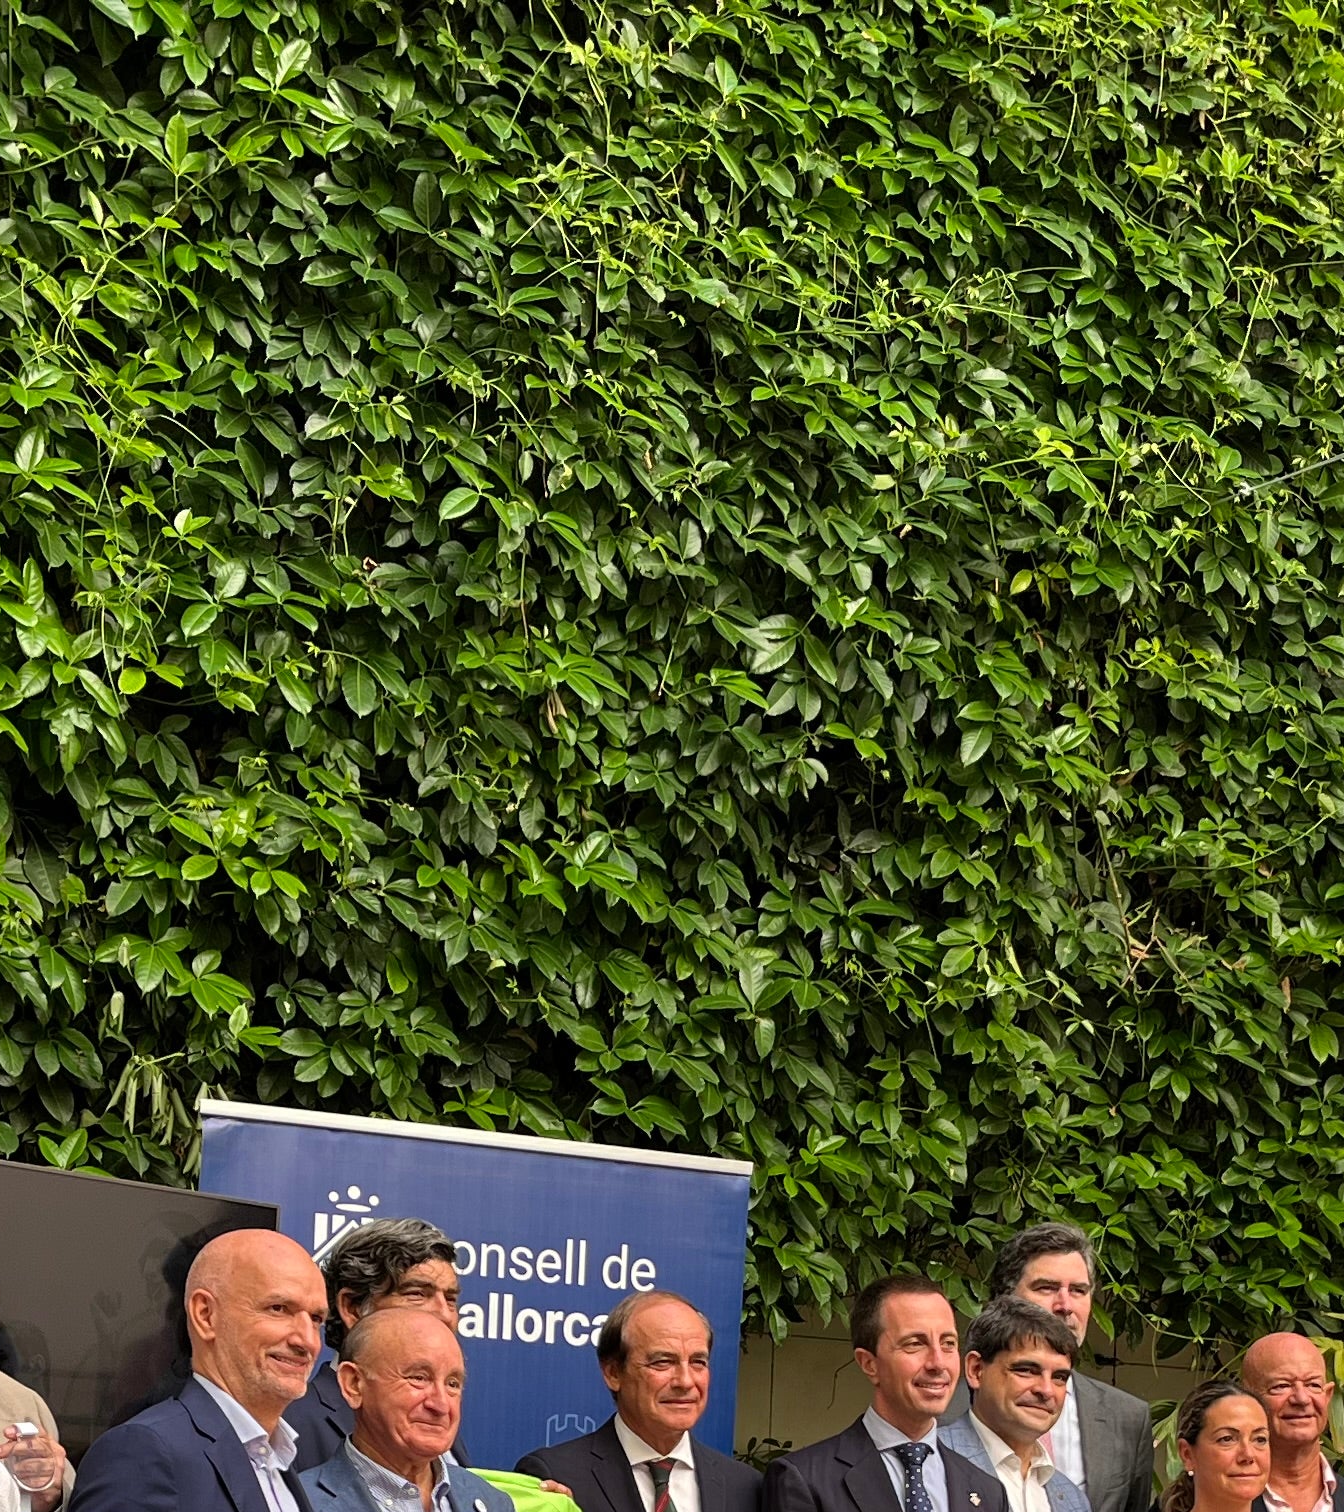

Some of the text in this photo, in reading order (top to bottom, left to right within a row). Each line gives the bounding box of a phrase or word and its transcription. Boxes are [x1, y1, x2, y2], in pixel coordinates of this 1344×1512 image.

[452, 1238, 656, 1292] onsell de
[458, 1292, 611, 1347] allorca
